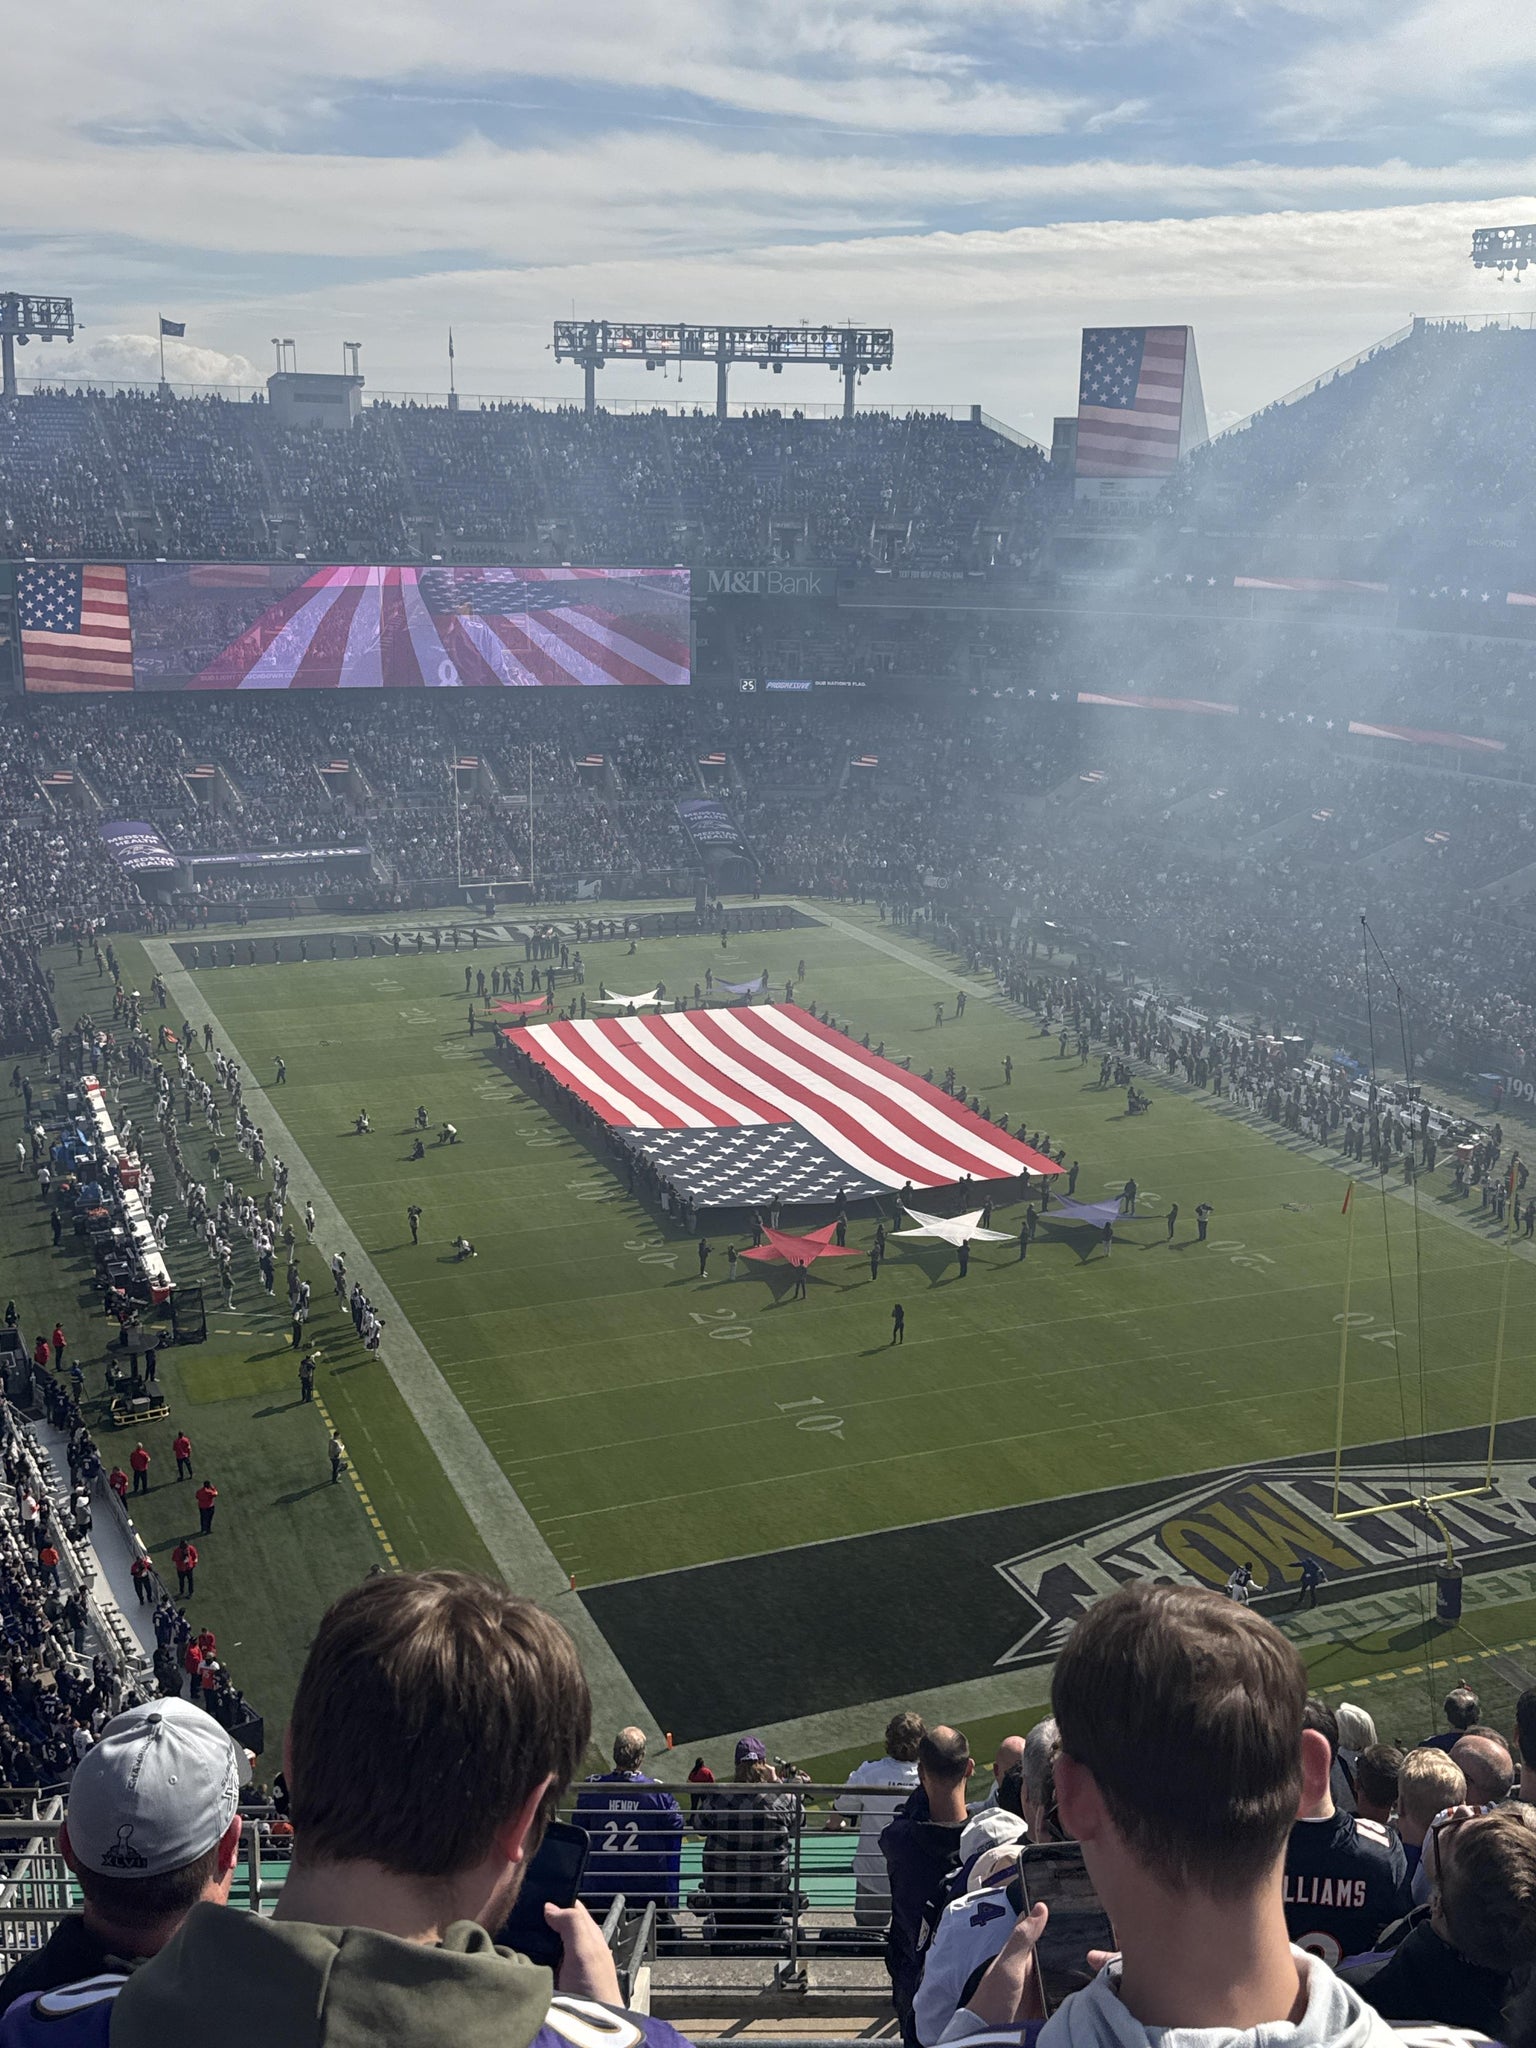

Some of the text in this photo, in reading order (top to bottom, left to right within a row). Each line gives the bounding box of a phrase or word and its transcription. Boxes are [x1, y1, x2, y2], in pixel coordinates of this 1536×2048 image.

[707, 570, 822, 594] M&T Bank
[742, 680, 754, 690] 25
[765, 681, 812, 690] PROGRESSIVE
[107, 834, 160, 844] MEDSTAR
[114, 839, 158, 847] HEALTH
[122, 856, 176, 866] MEDSTAR
[131, 861, 175, 869] HEALTH
[257, 849, 361, 860] RAVENS
[433, 1041, 474, 1059] 30
[1506, 1077, 1536, 1106] 199
[515, 1127, 562, 1148] 50
[622, 1236, 680, 1266] 30
[1207, 1240, 1277, 1268] 20
[688, 1308, 754, 1341] 20
[774, 1395, 845, 1434] 10
[1006, 1468, 1536, 1652] ALTIMORE
[1321, 1592, 1432, 1630] ALL
[608, 1799, 640, 1811] HENRY
[602, 1820, 640, 1852] 22
[969, 1902, 1007, 1928] 4
